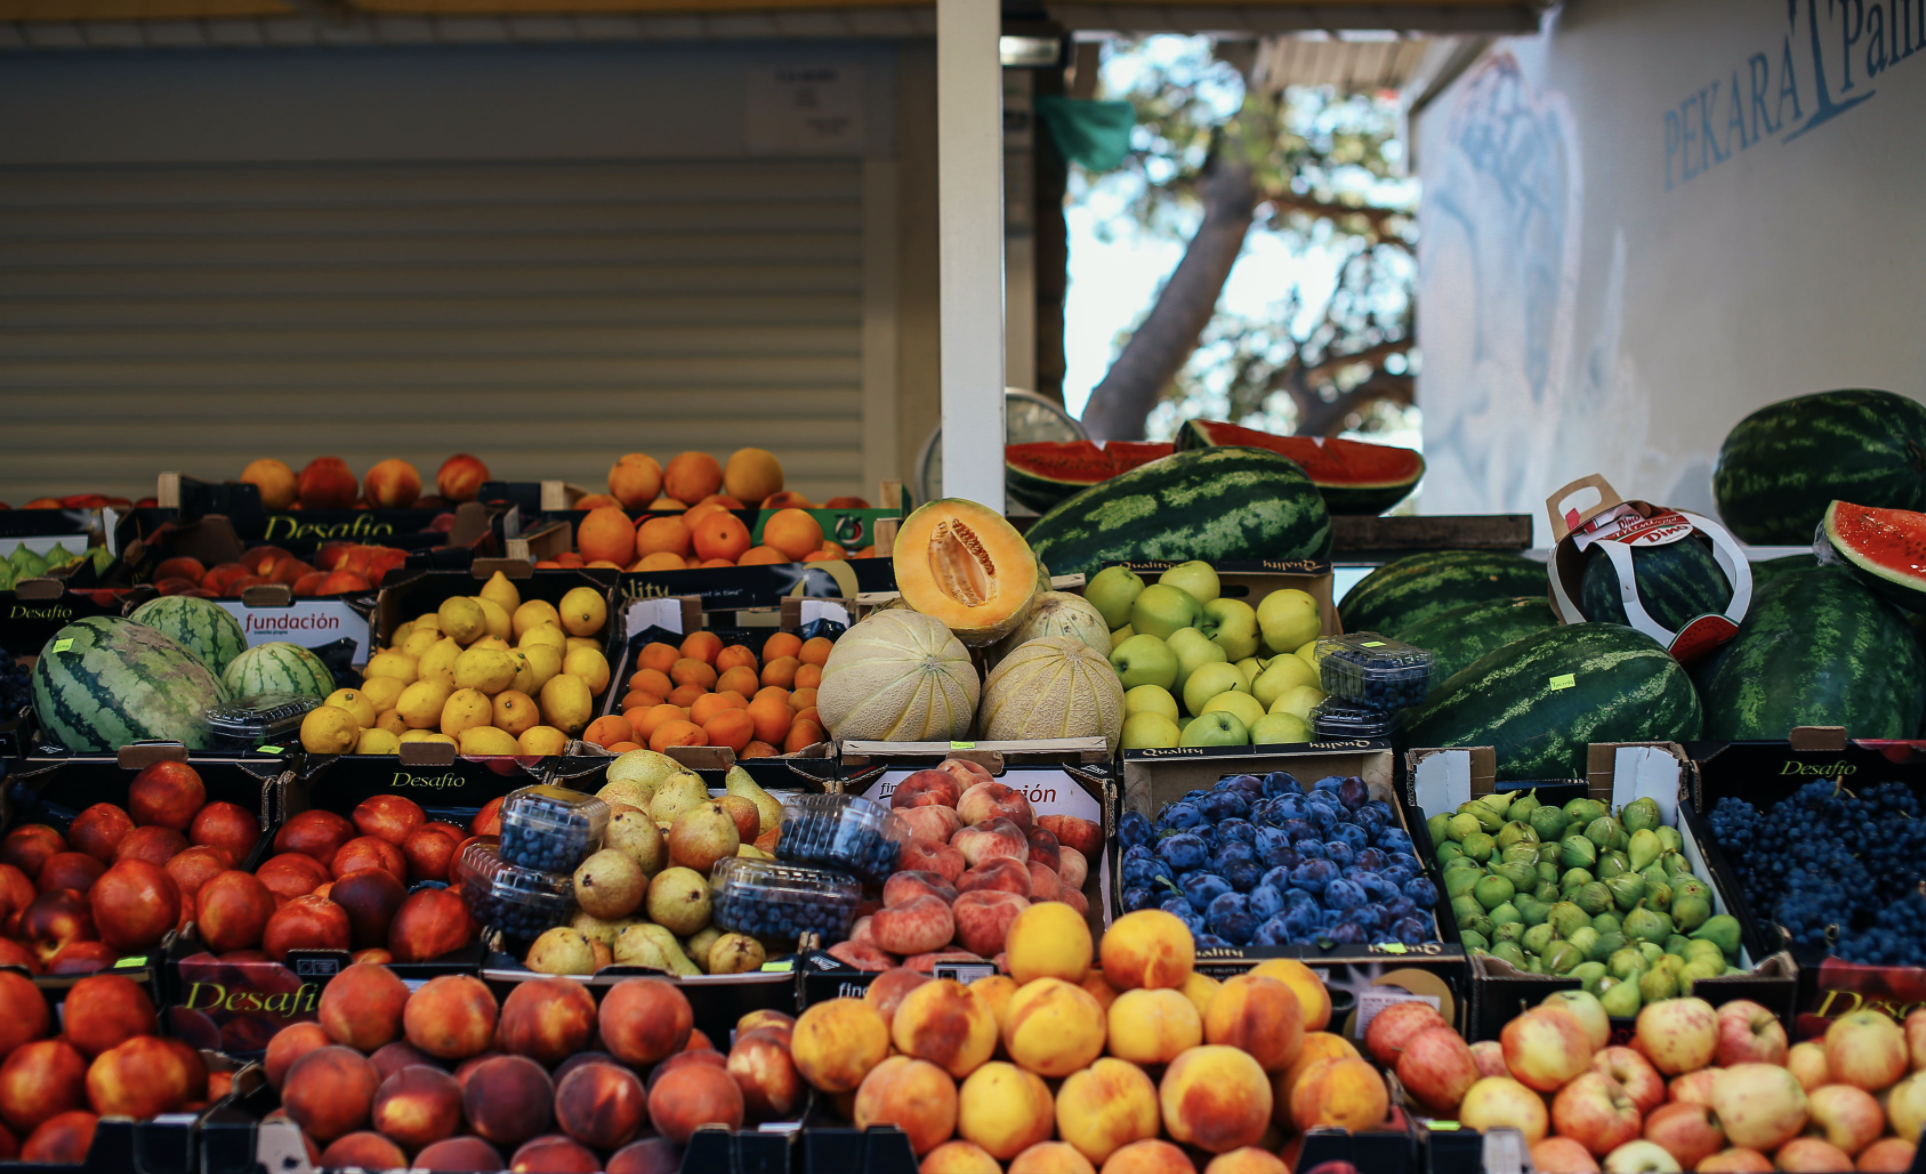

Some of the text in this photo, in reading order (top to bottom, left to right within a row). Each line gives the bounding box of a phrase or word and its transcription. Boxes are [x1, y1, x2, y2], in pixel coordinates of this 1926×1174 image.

[1663, 34, 1804, 192] PEKARA
[1643, 525, 1688, 543] Dino
[10, 604, 73, 620] Desafio
[245, 612, 340, 634] fundación
[1142, 748, 1204, 757] Quality
[1309, 739, 1371, 749] Quality
[1779, 759, 1857, 778] Desafio
[390, 772, 465, 790] Desafio
[184, 981, 323, 1018] Desafi
